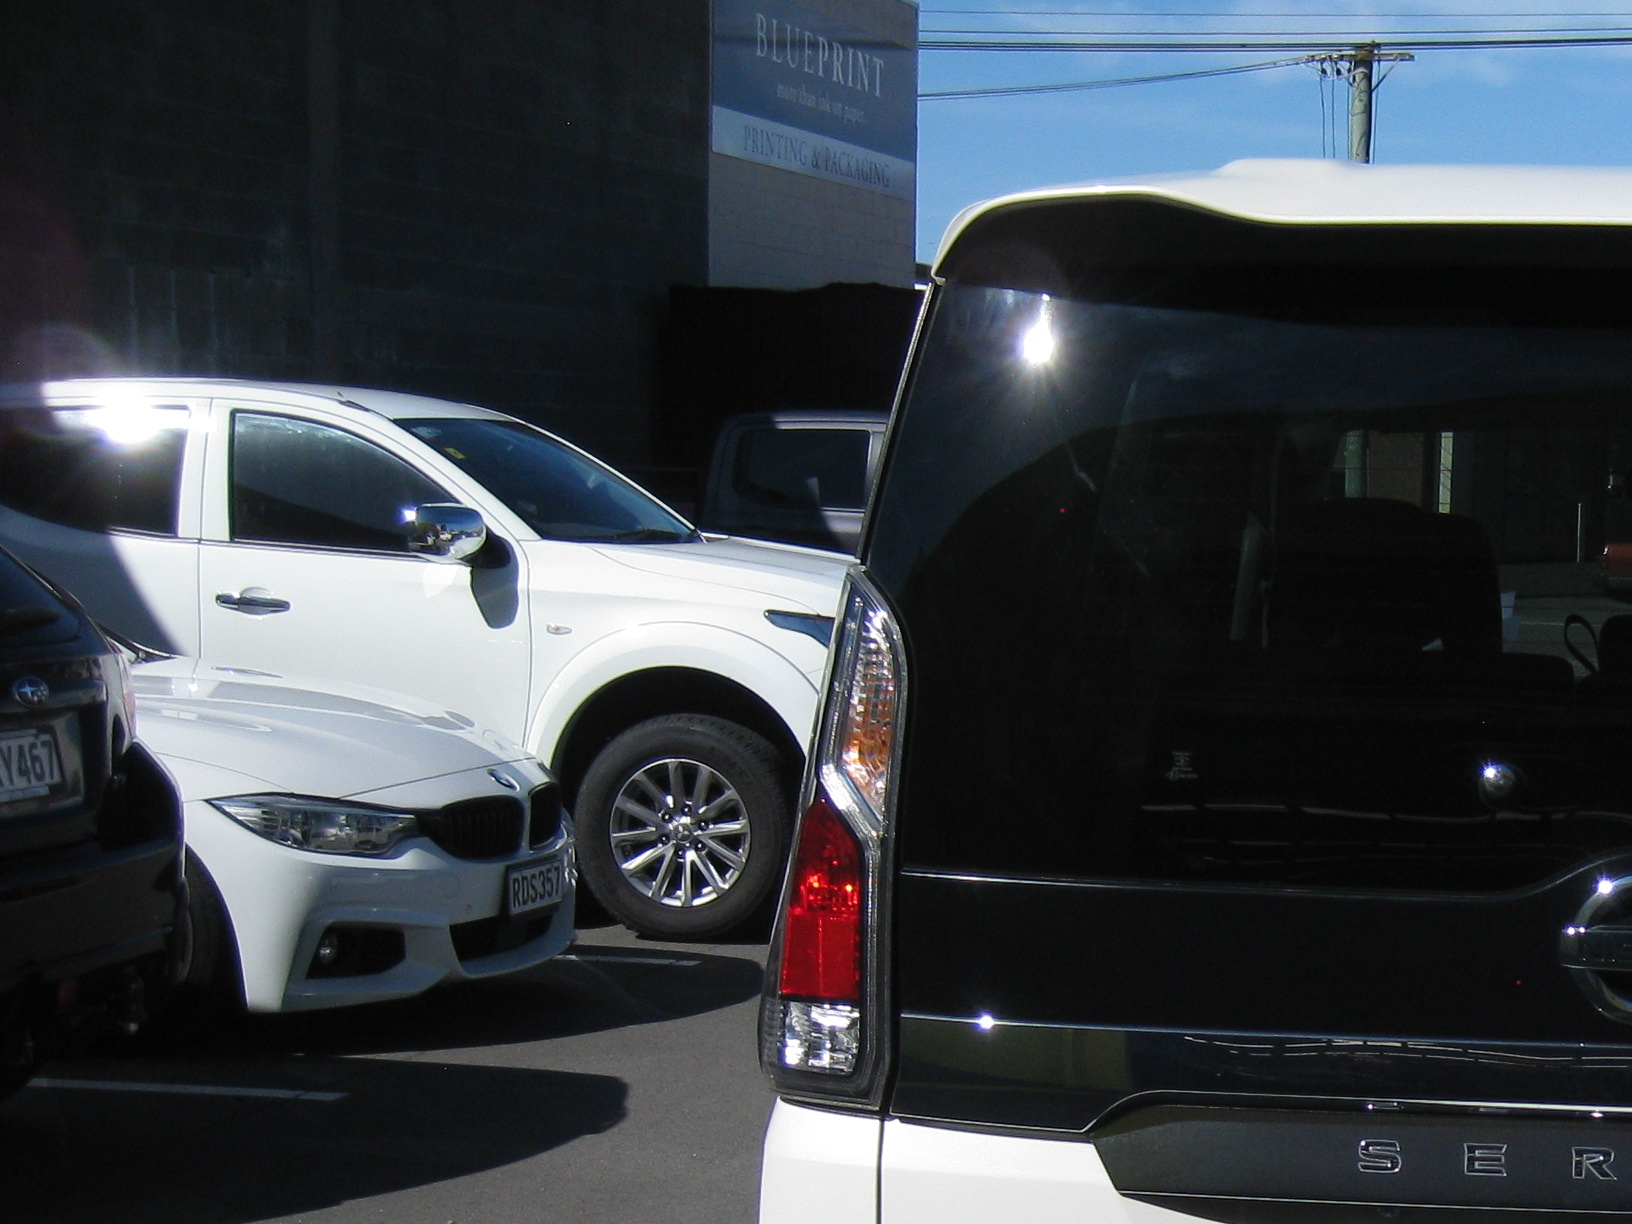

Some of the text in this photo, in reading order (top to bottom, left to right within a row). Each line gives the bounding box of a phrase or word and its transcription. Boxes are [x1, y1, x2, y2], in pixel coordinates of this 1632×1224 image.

[755, 13, 884, 97] BLUEPRINT
[743, 125, 890, 188] PRINTING & PACKAGING
[0, 741, 55, 786] Y467
[512, 866, 560, 908] RDS357
